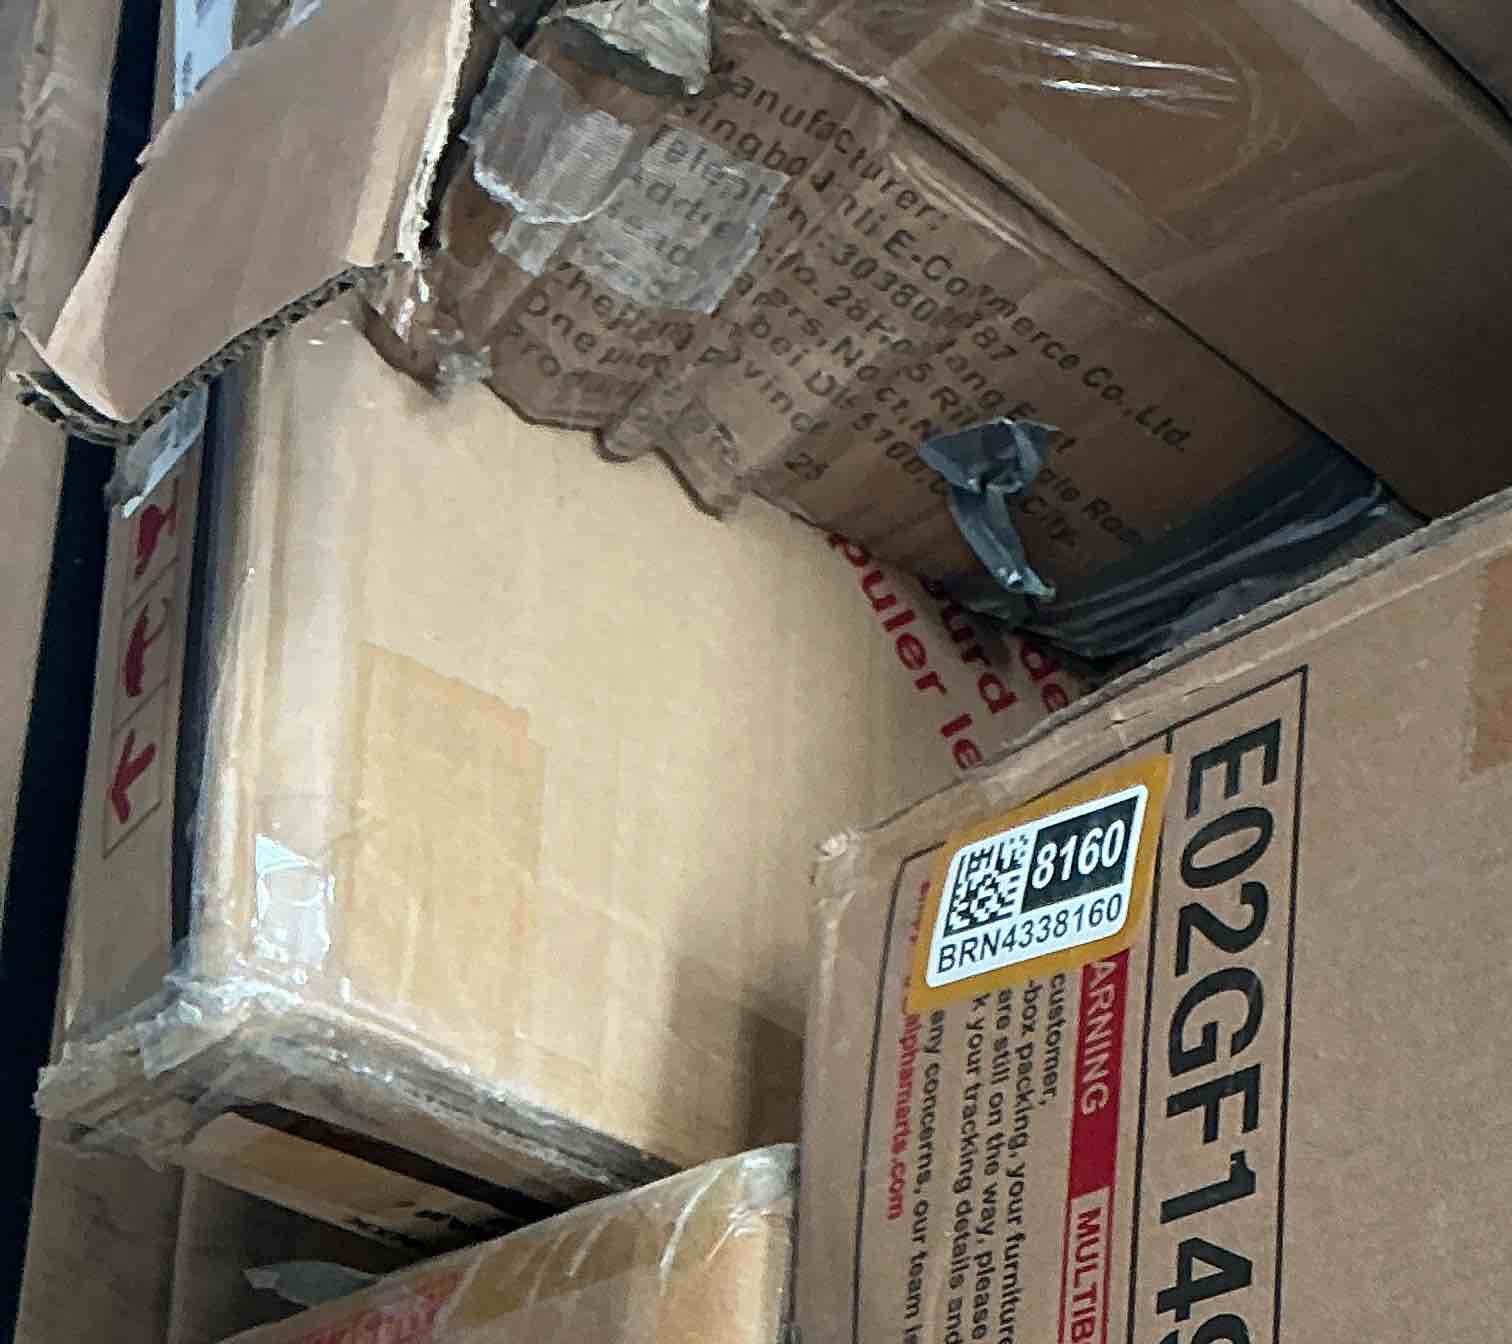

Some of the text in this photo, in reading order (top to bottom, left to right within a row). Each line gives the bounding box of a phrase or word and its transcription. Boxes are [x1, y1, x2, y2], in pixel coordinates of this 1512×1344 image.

[1032, 819, 1125, 890] 8160
[937, 893, 1124, 975] BRN4338160
[924, 1010, 944, 1053] any
[966, 1017, 984, 1075] your
[991, 1036, 1010, 1084] still
[1042, 974, 1065, 1105] customer,
[1080, 959, 1116, 1117] ARNING
[917, 1063, 939, 1194] concerns,
[987, 1092, 1003, 1126] on
[1009, 1042, 1034, 1158] packing,
[955, 1083, 981, 1194] tracking
[984, 1132, 1006, 1176] the
[912, 1200, 928, 1243] our
[1006, 1163, 1025, 1225] your
[950, 1200, 973, 1290] details
[904, 1251, 928, 1319] team
[971, 1251, 994, 1339] please
